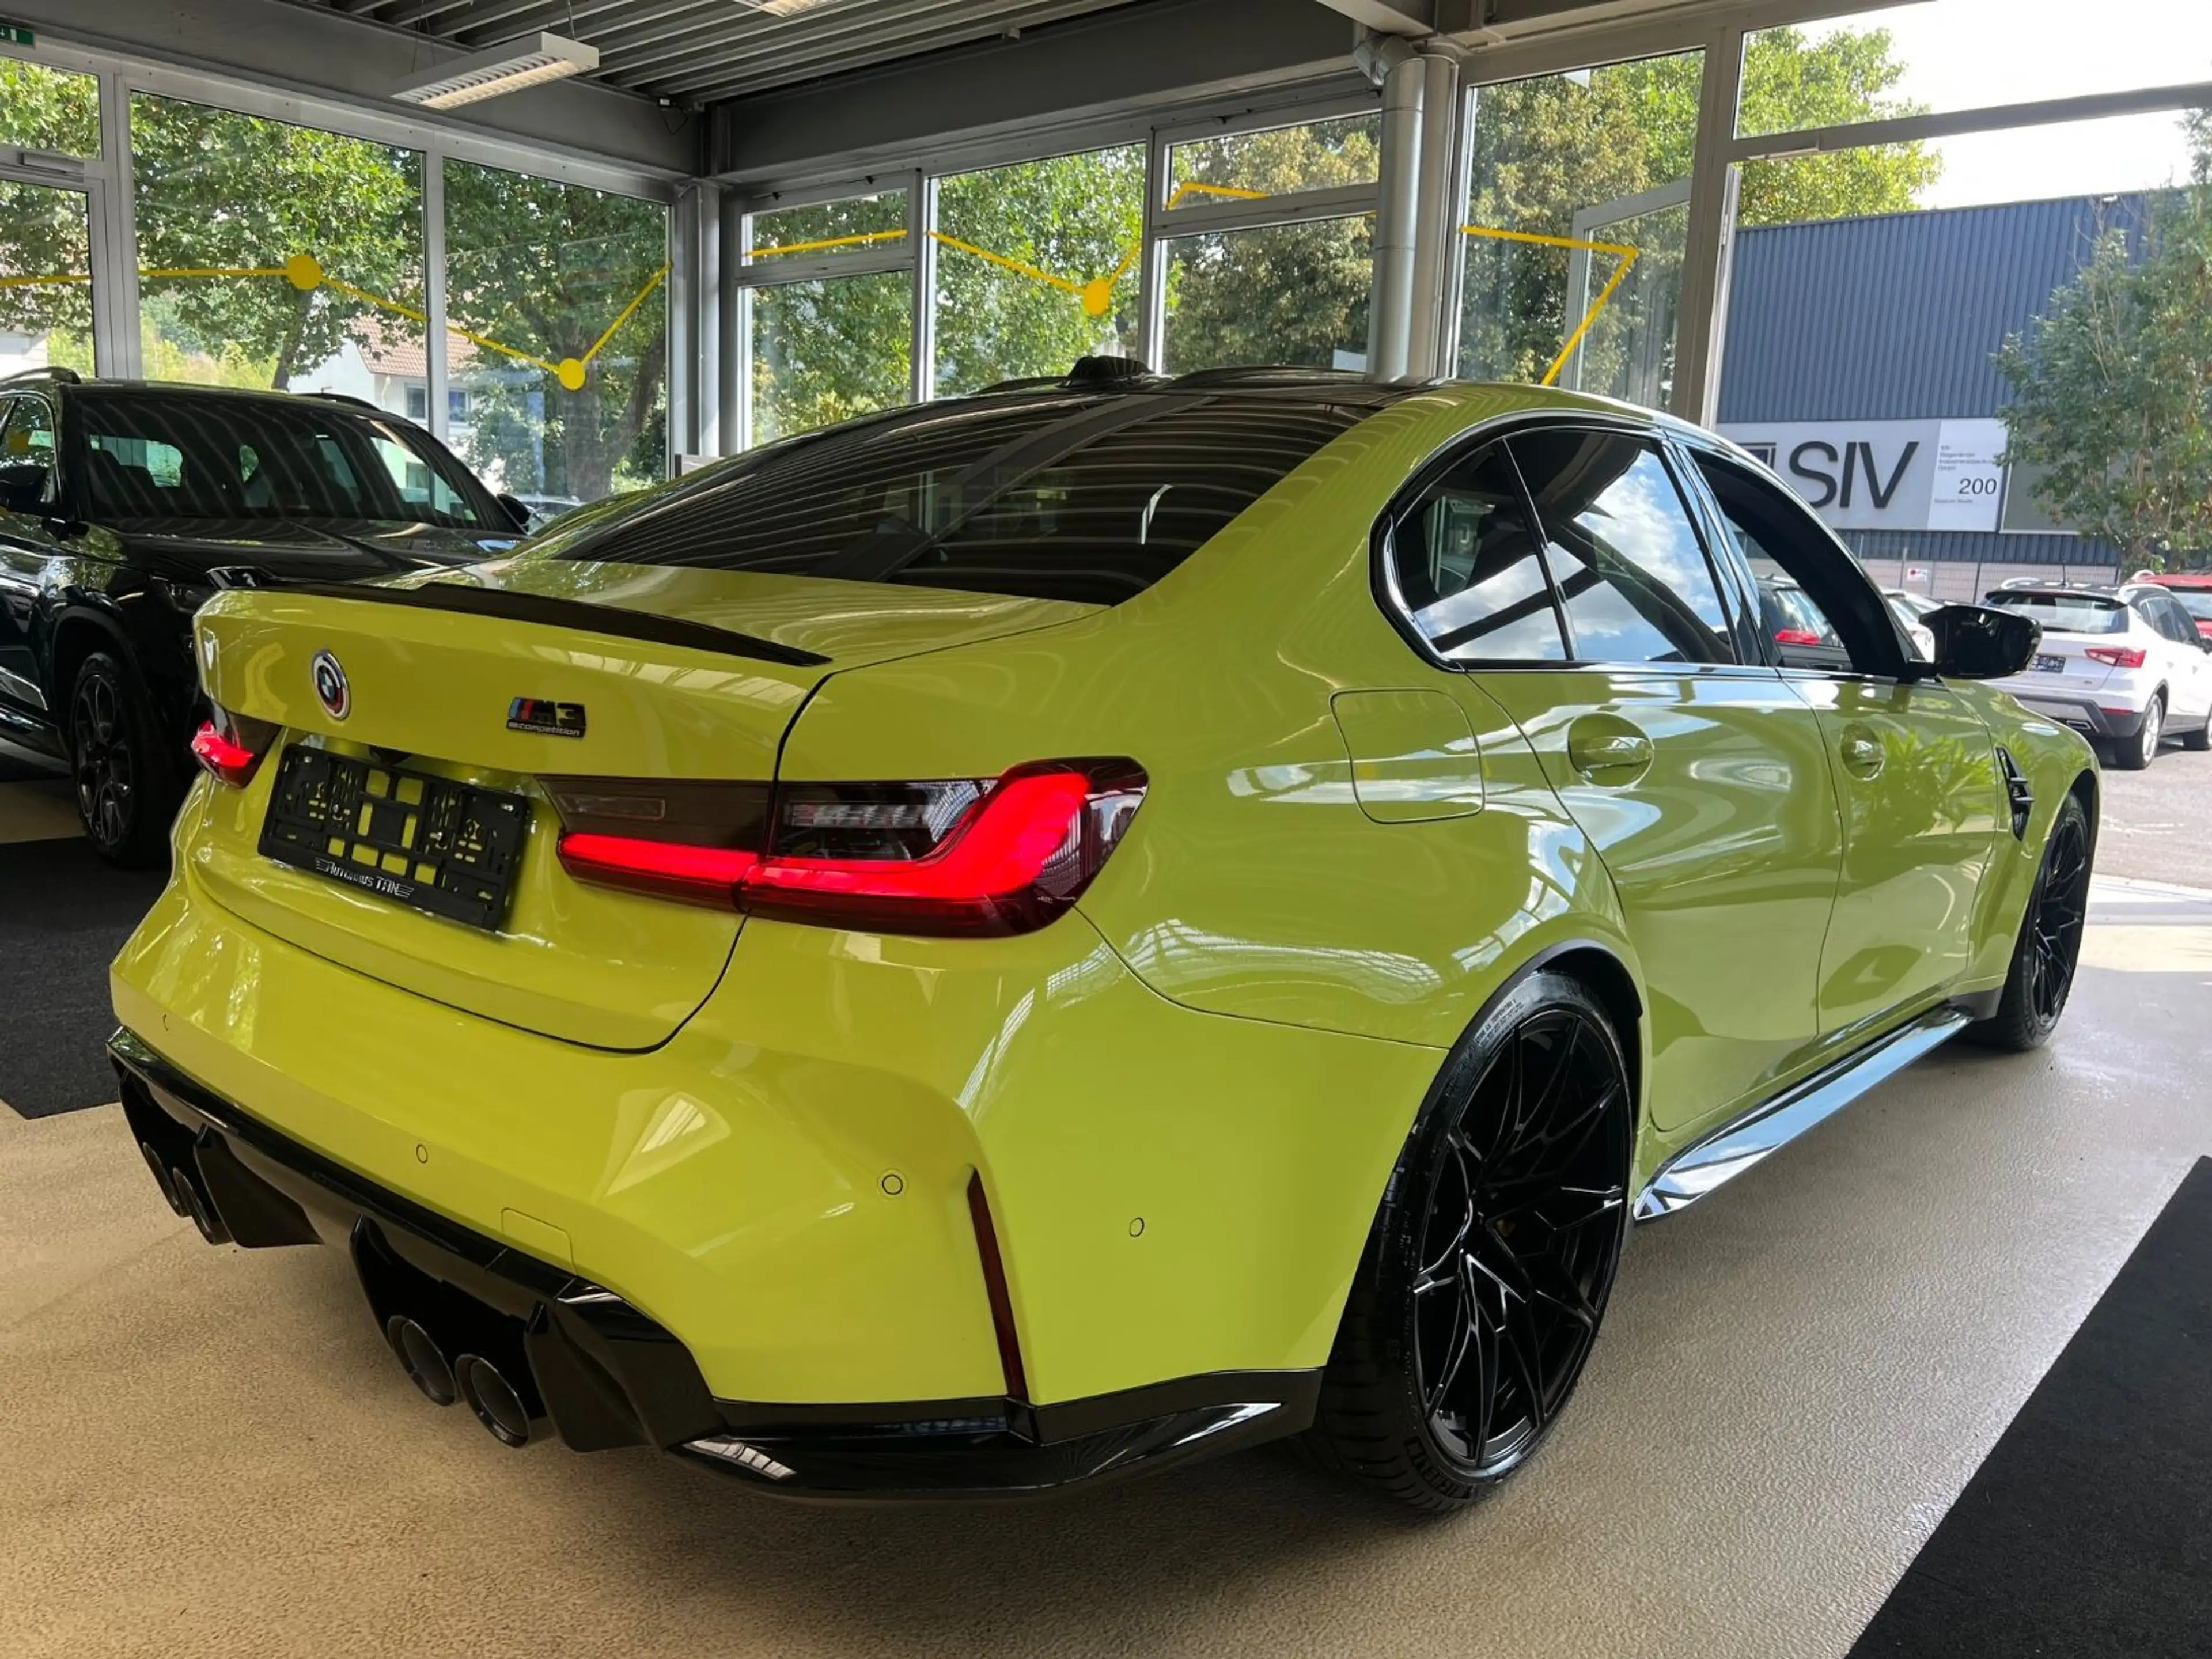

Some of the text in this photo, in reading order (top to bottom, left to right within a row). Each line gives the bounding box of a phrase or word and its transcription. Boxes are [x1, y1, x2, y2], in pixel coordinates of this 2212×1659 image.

[1789, 441, 1919, 509] SIV
[1958, 478, 1997, 495] 200
[509, 697, 586, 728] M3
[375, 875, 403, 896] TAN
